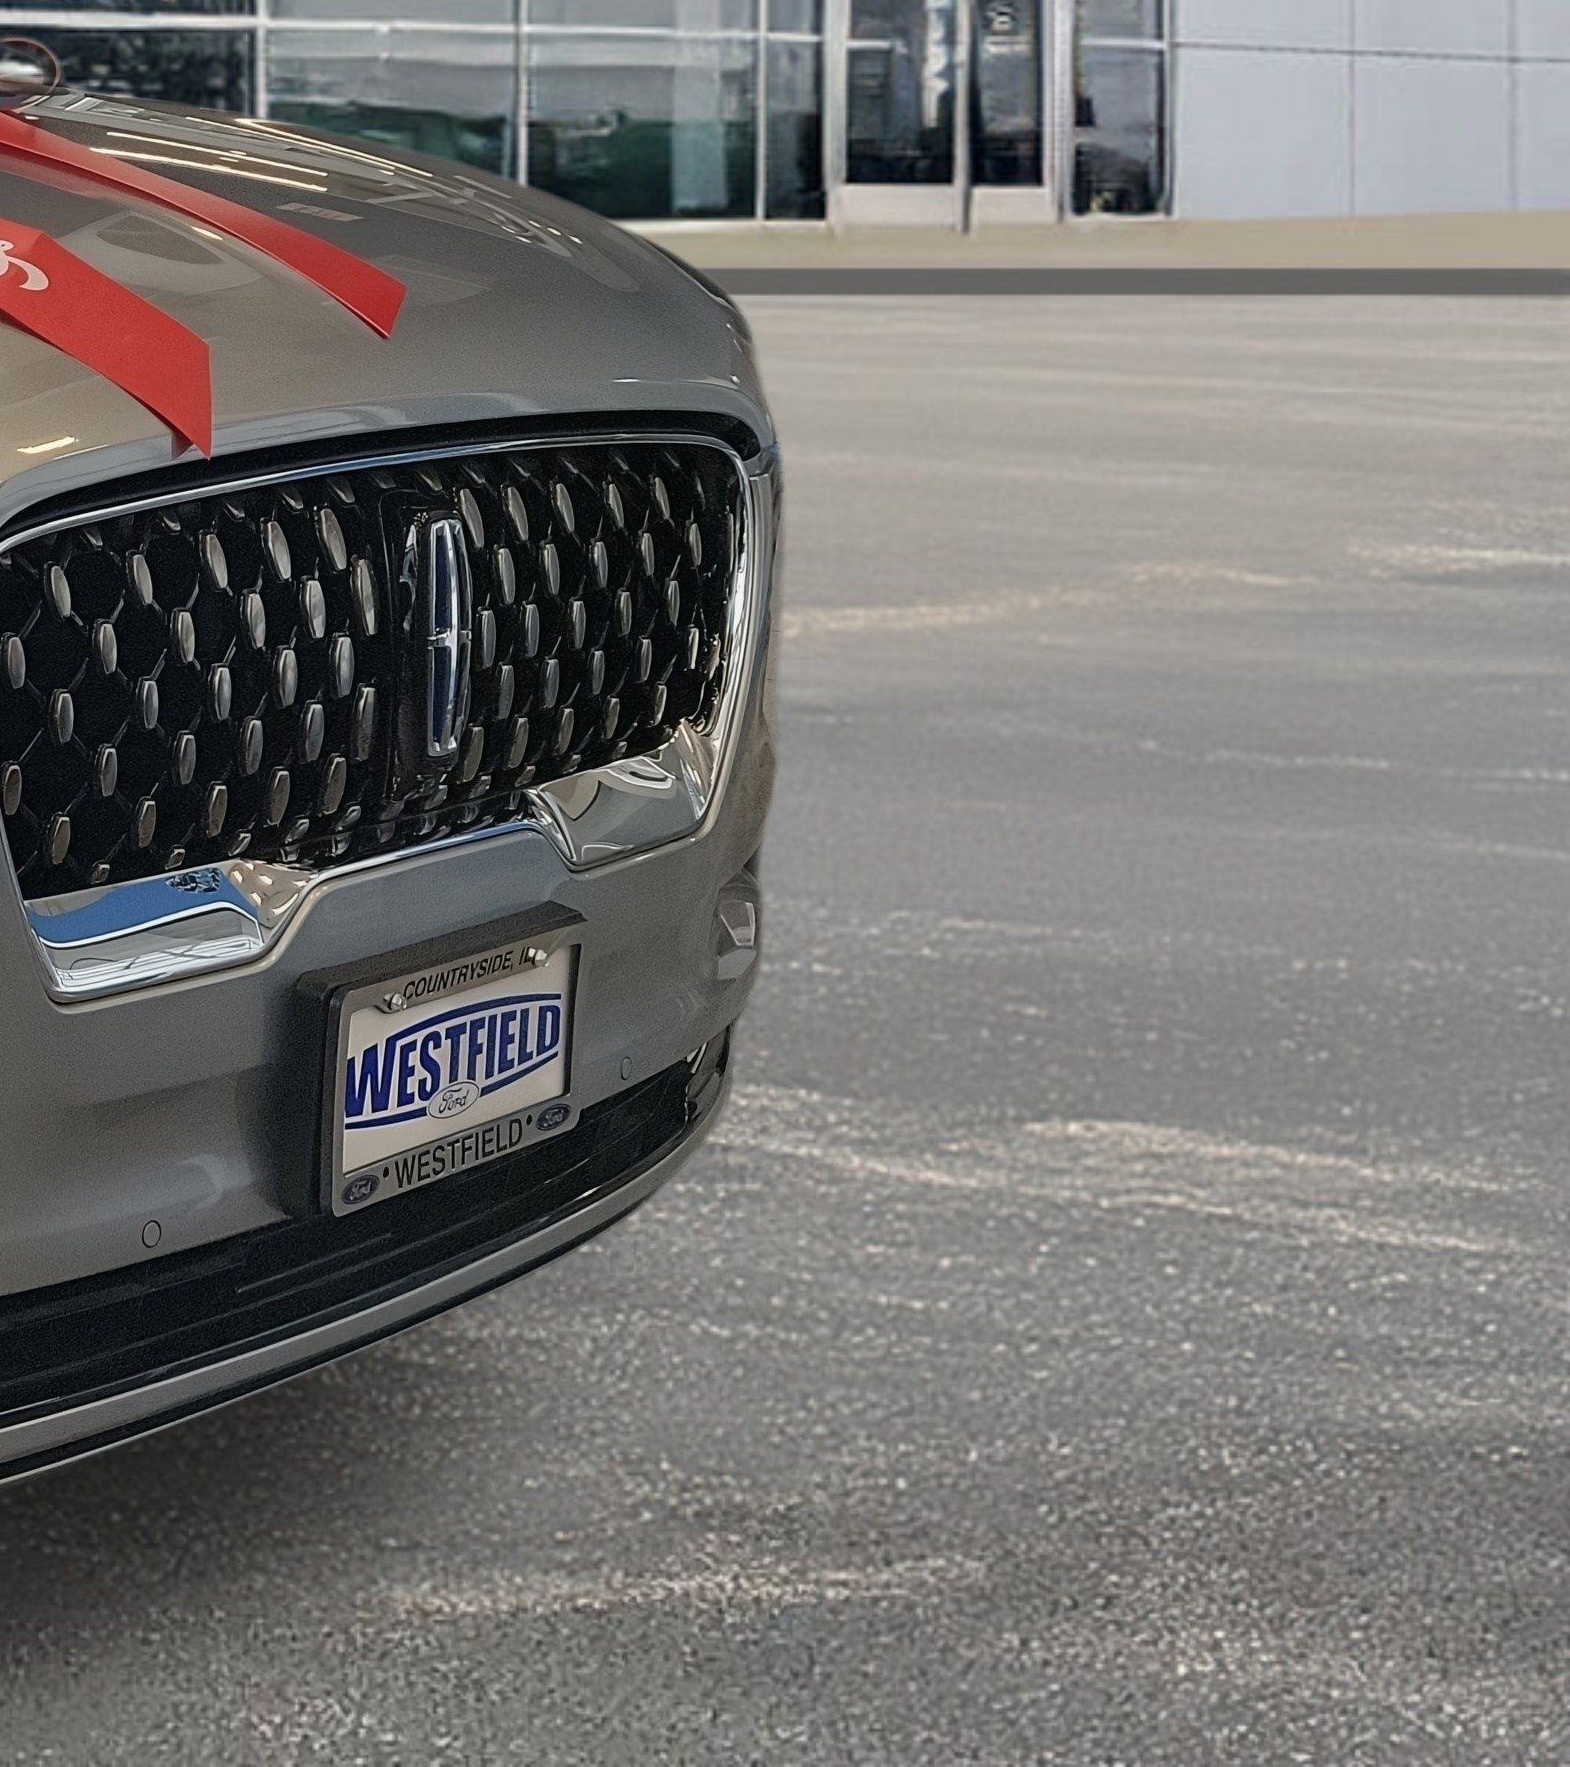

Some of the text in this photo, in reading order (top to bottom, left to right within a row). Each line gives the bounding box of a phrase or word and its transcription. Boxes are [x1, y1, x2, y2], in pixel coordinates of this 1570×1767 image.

[402, 949, 515, 1002] COUNTRYSIDE,
[345, 1004, 562, 1118] WESTFIELD
[437, 1087, 470, 1114] Ford
[394, 1118, 524, 1189] WESTFIELD
